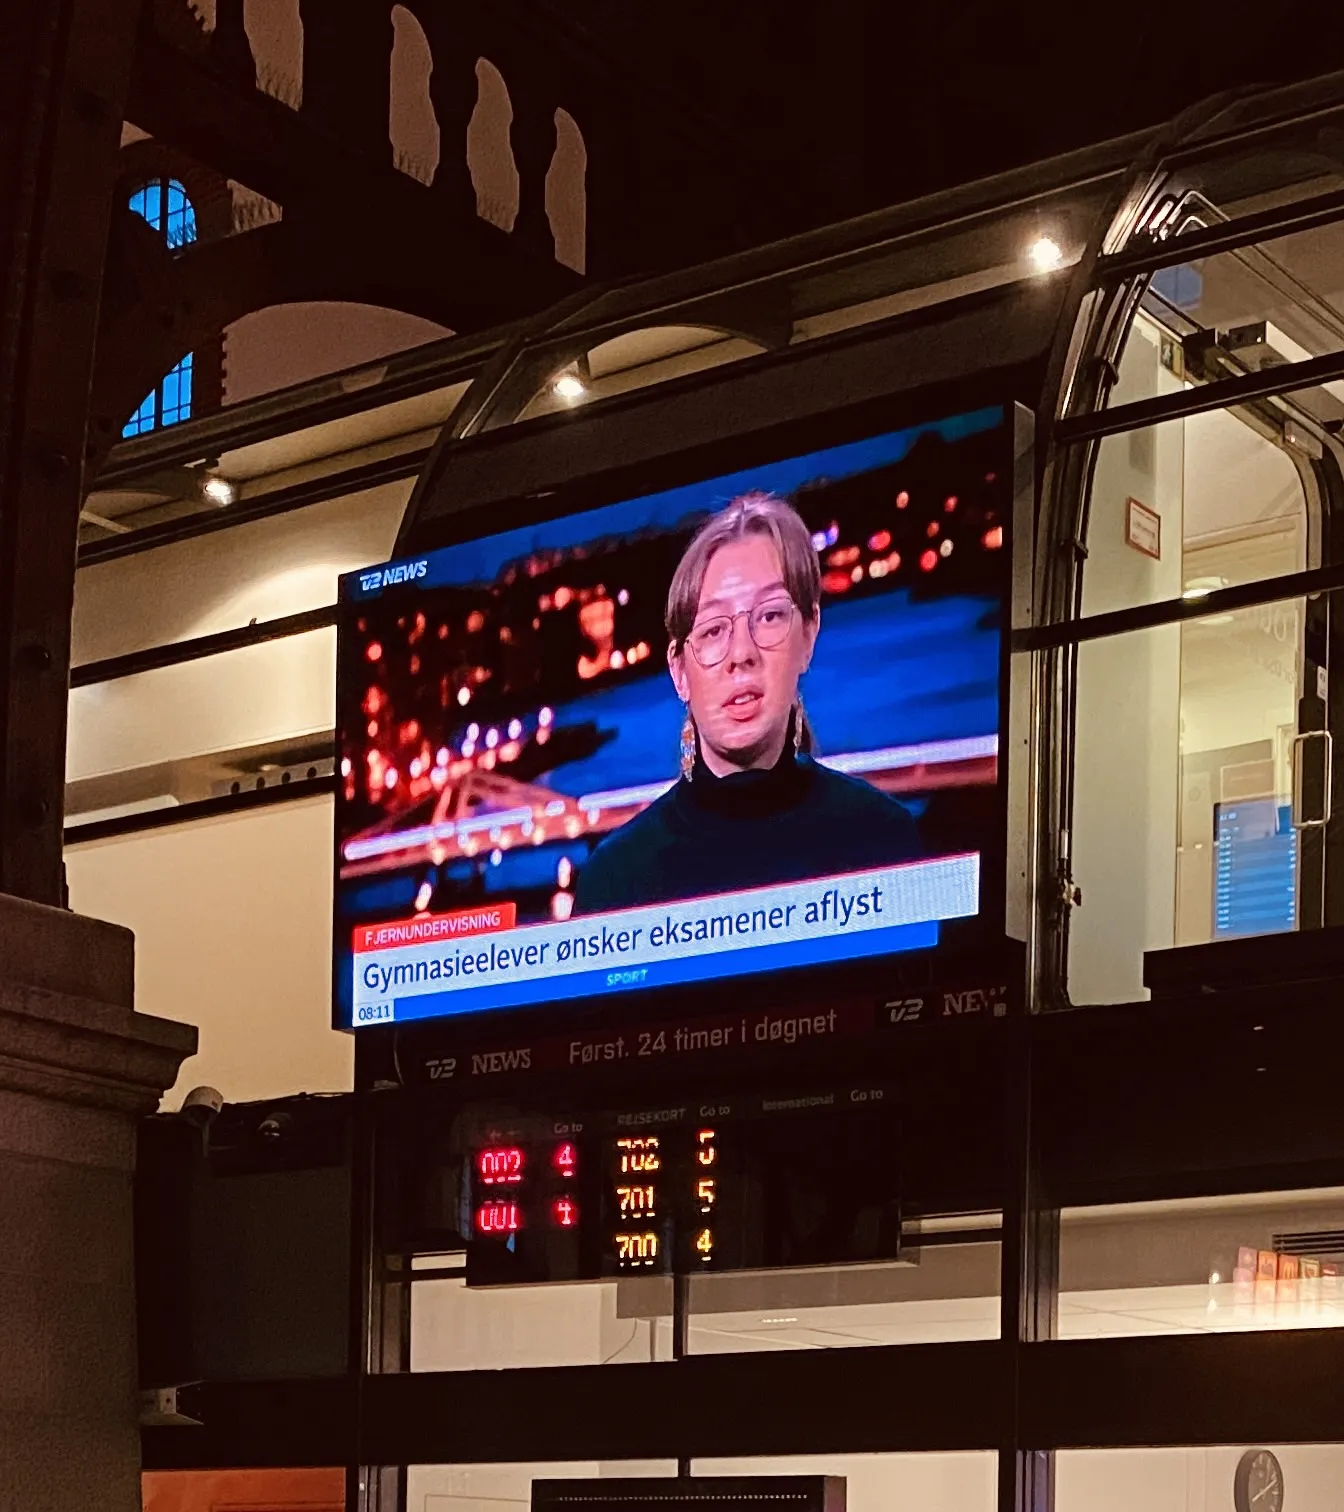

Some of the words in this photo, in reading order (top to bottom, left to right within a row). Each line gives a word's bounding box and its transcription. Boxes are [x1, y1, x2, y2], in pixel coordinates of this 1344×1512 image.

[383, 561, 427, 586] NEWS
[363, 941, 550, 993] Gymnasieelever
[556, 929, 643, 962] ønsker
[650, 903, 798, 946] eksamener
[804, 886, 883, 927] aflyst
[365, 911, 501, 946] FJERNUNDERVISNING
[606, 969, 648, 987] SPORT
[358, 1005, 391, 1022] 08:11
[471, 1050, 532, 1075] NEWS
[569, 1037, 630, 1065] Først.
[638, 1031, 667, 1057] 24
[674, 1027, 734, 1051] timer
[741, 1019, 747, 1043] i
[755, 1009, 837, 1044] døgnet
[850, 1089, 867, 1102] Go
[870, 1088, 883, 1101] to
[699, 1106, 716, 1117] Go
[718, 1104, 731, 1116] to
[554, 1122, 570, 1133] Go
[571, 1121, 583, 1133] to
[617, 1185, 656, 1221] 701
[698, 1180, 715, 1213] 5
[616, 1232, 657, 1268] 700
